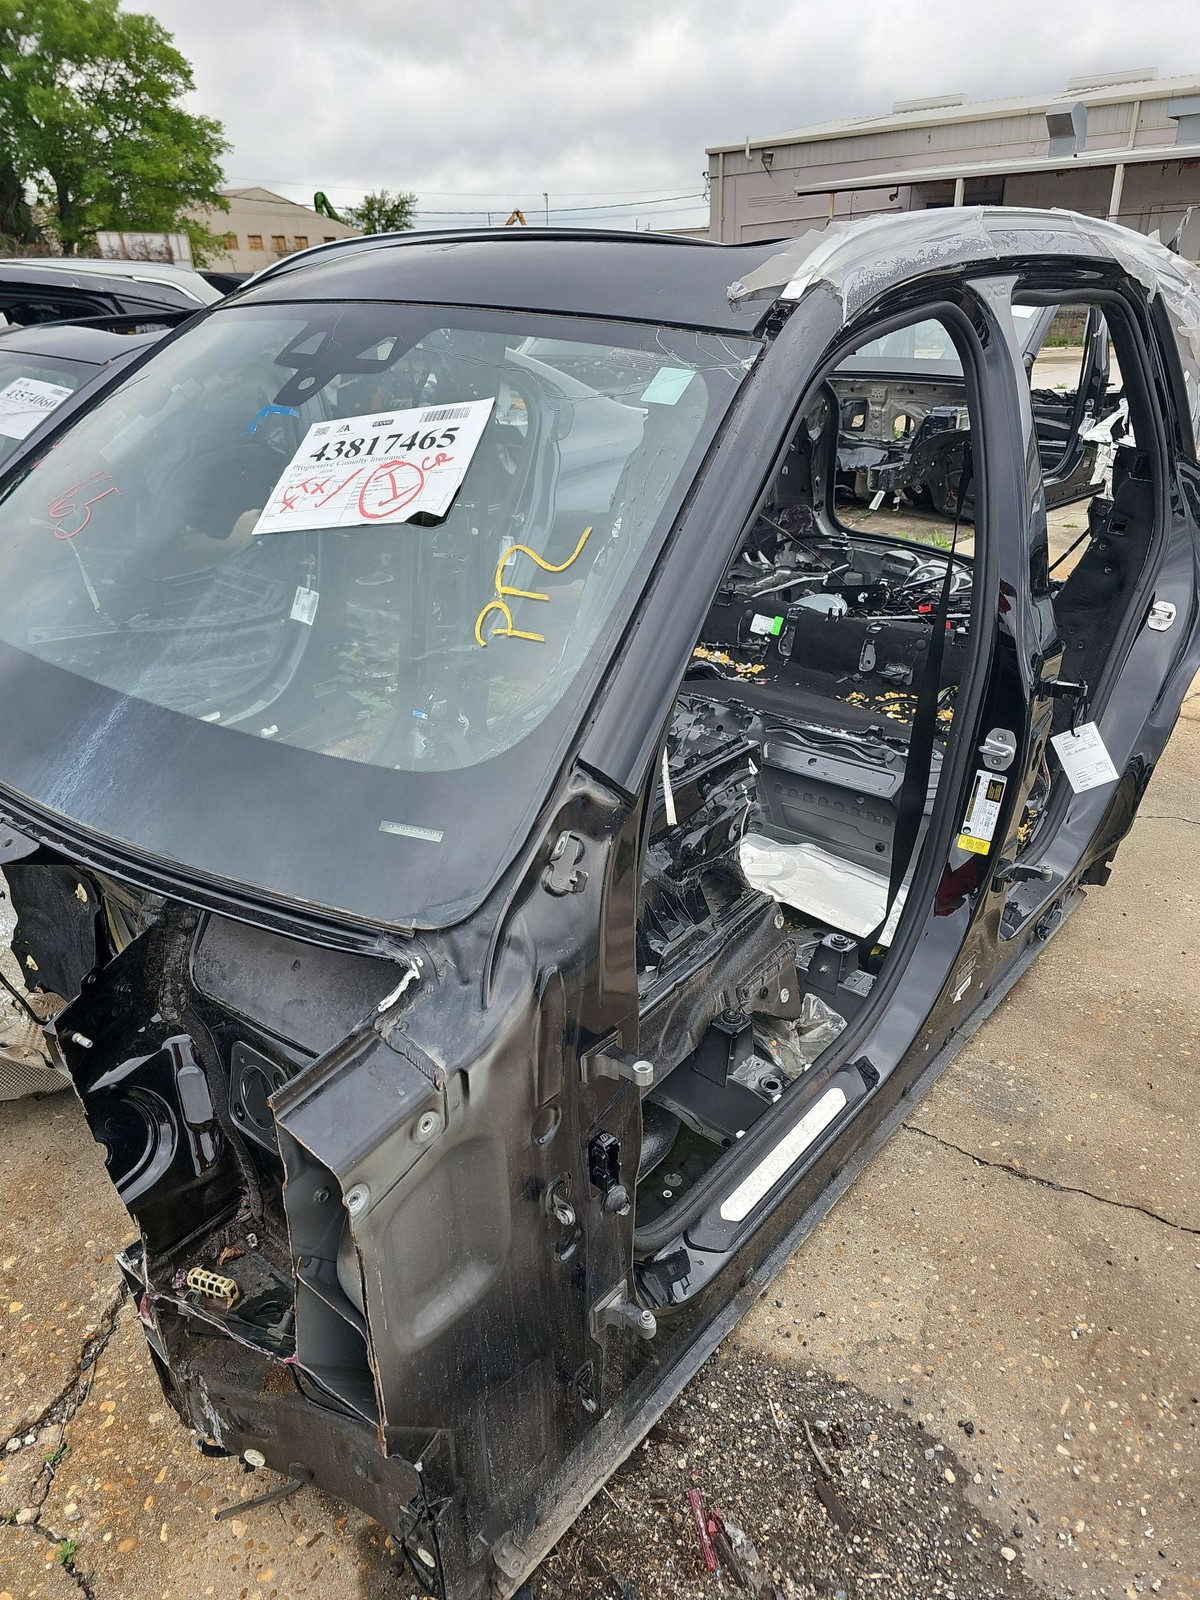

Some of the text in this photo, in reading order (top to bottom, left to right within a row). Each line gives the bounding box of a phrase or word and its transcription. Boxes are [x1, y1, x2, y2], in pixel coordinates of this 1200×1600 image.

[309, 426, 461, 462] 43817465
[292, 454, 408, 472] Progressive Casualty Insurance
